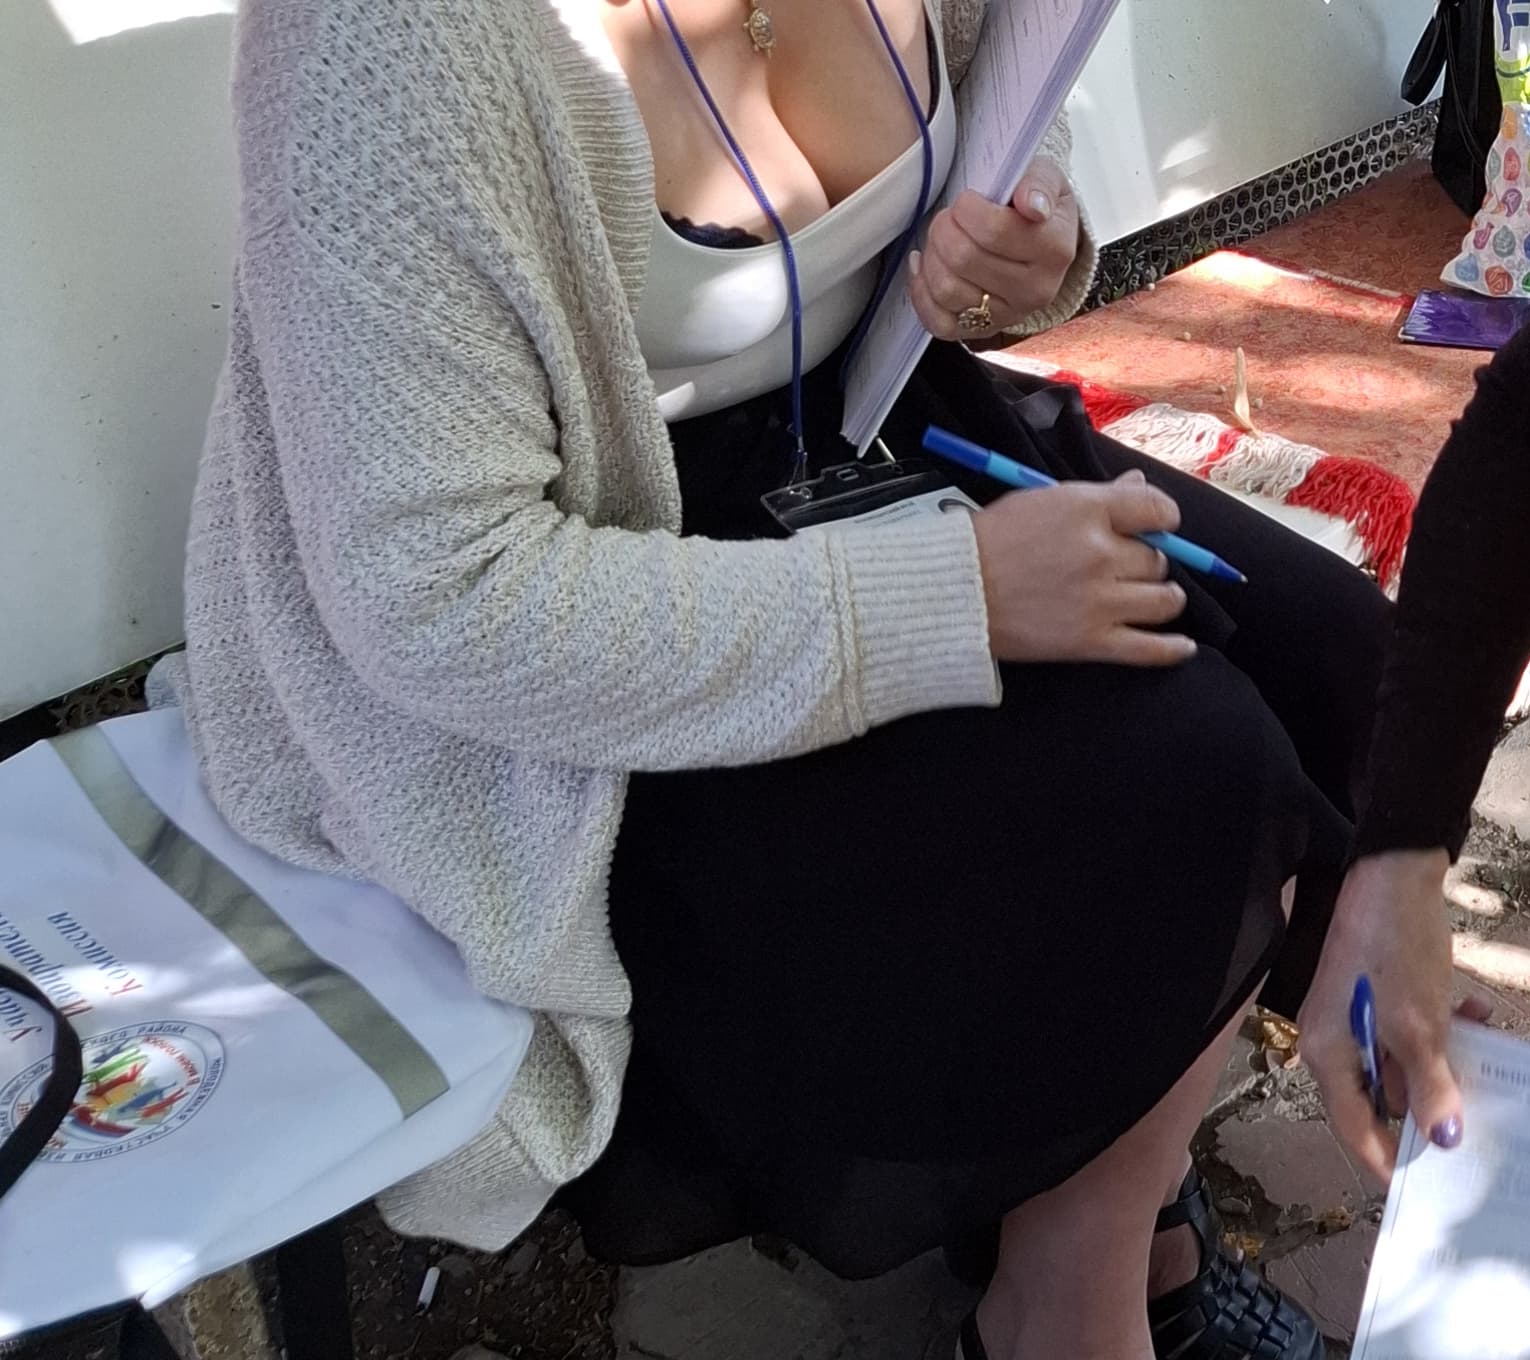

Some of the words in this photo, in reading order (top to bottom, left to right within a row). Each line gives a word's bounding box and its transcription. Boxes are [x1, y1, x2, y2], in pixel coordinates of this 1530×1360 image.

[0, 913, 94, 1018] Избирател
[47, 911, 144, 996] Комиссия
[136, 1023, 188, 1036] РАЙОНА
